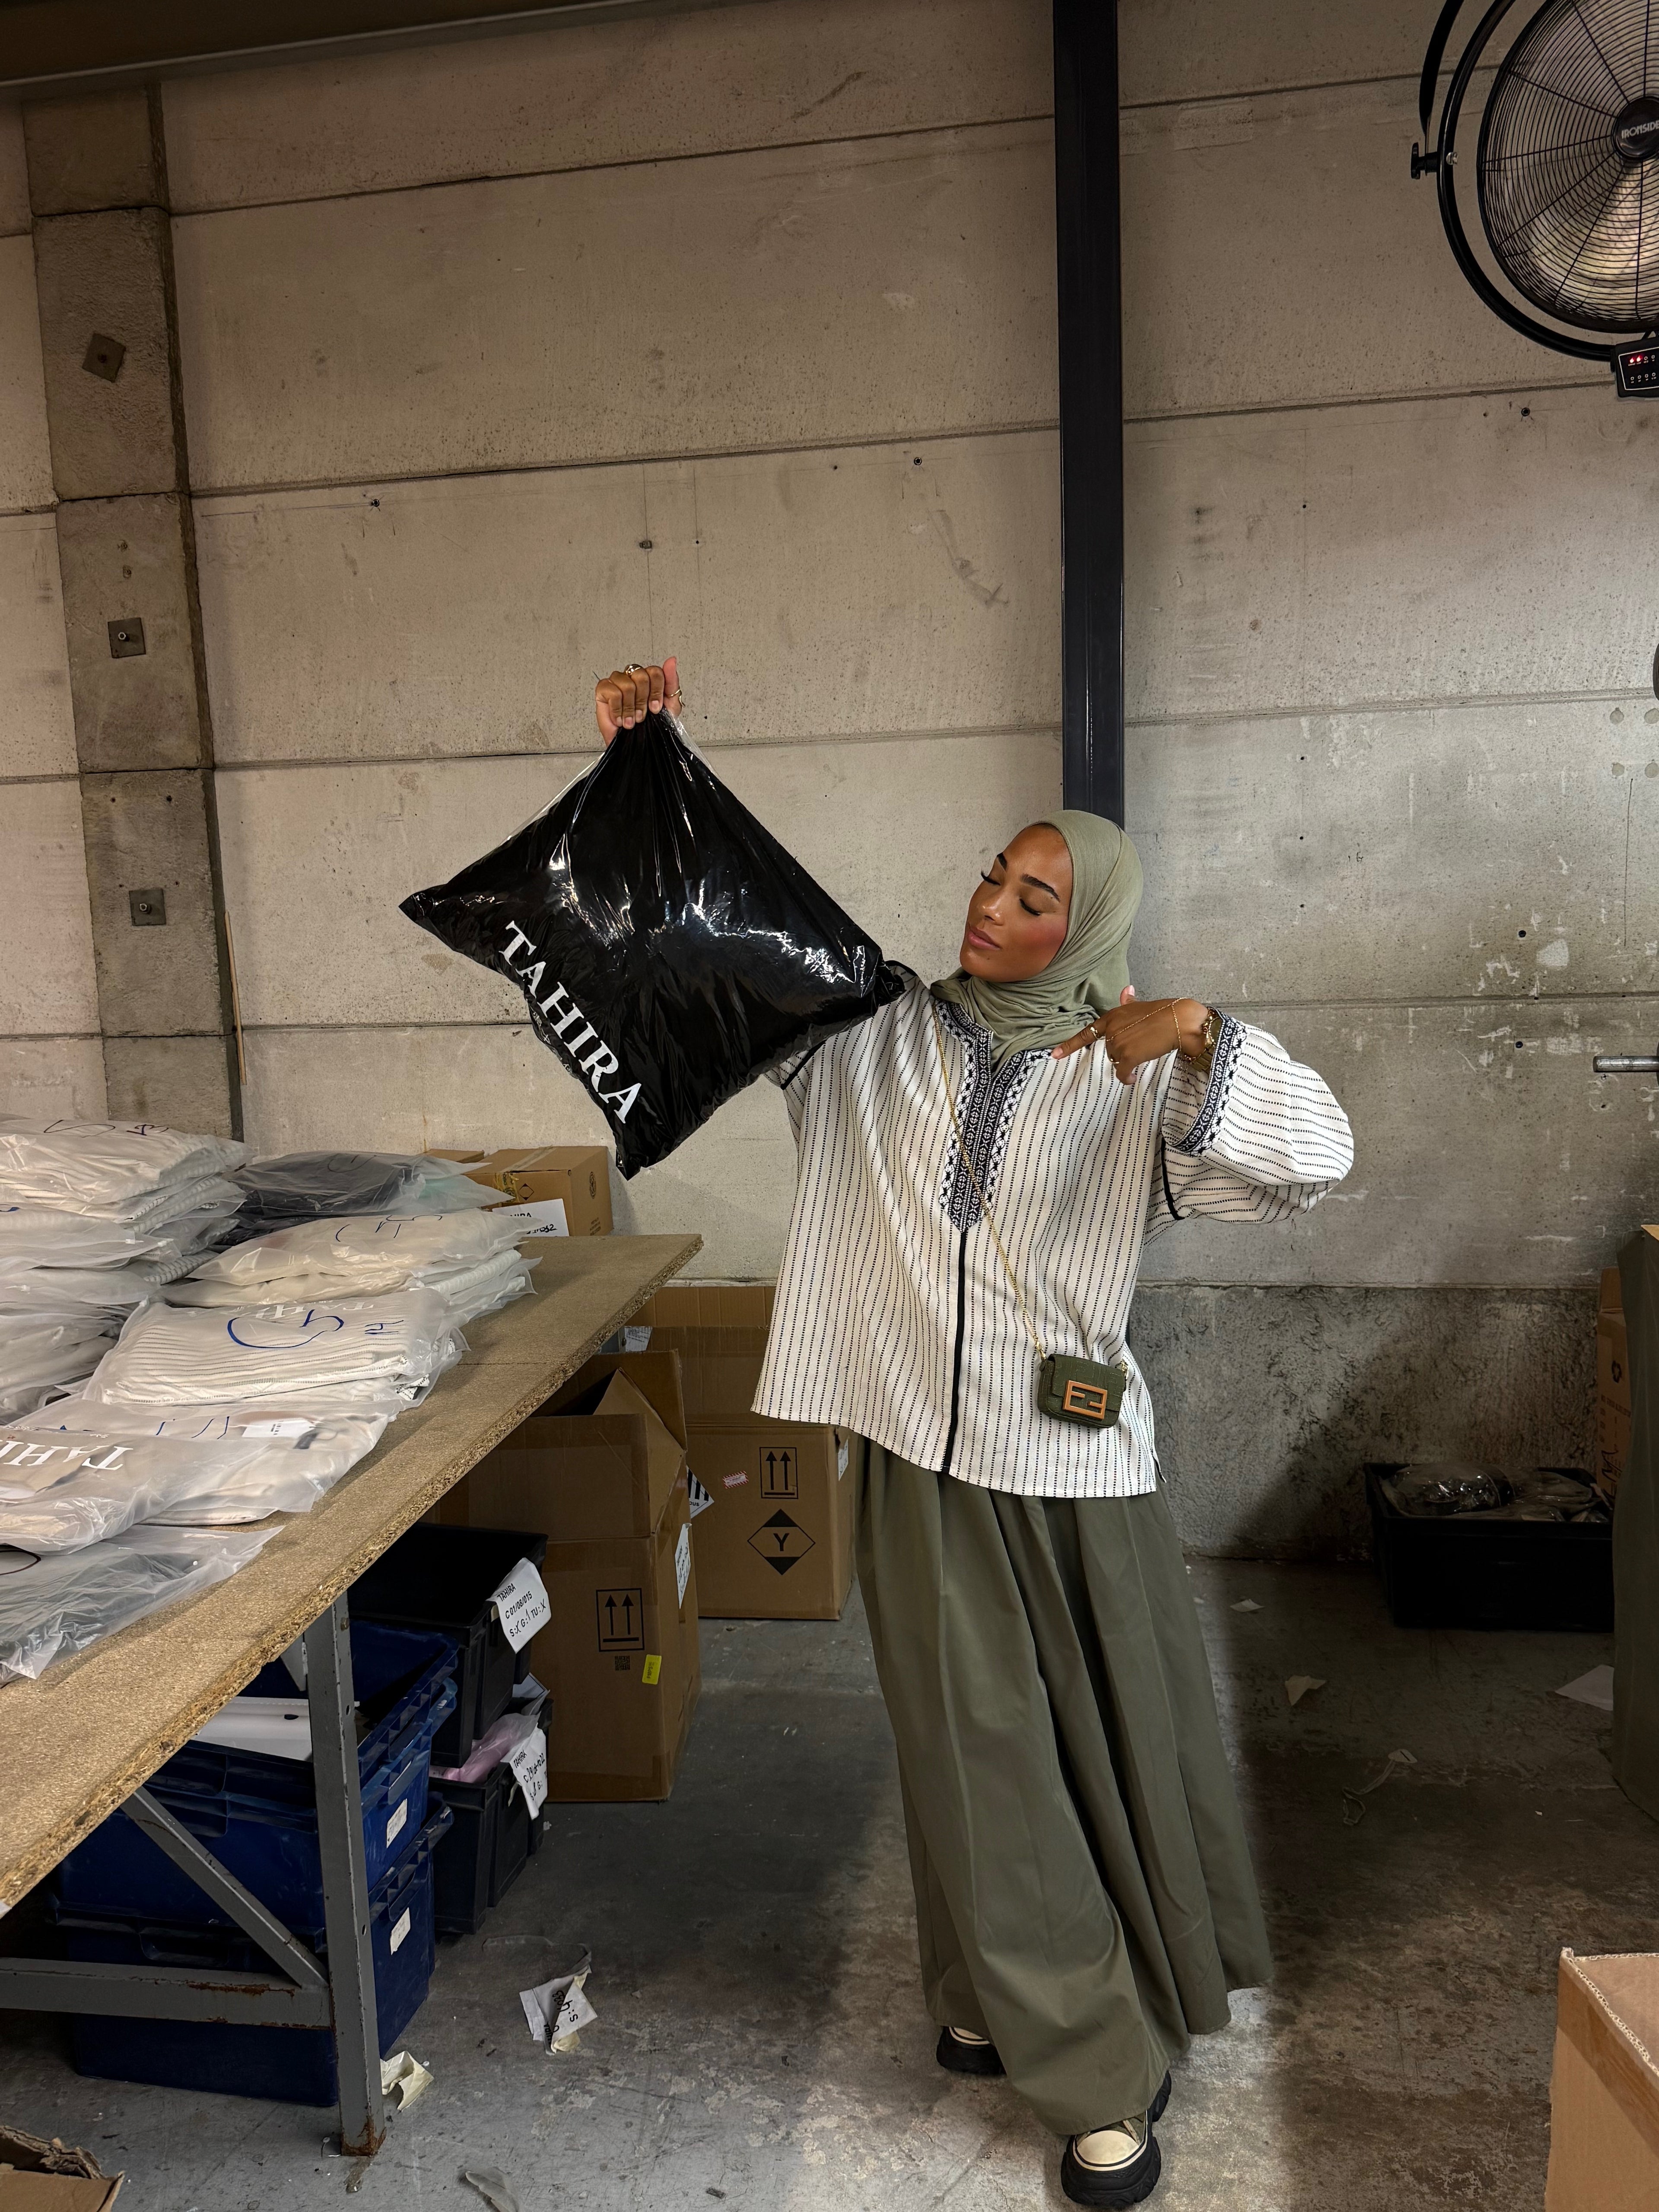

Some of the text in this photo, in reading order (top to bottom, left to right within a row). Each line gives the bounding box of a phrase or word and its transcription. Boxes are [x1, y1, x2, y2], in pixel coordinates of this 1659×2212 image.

[1621, 120, 1659, 139] IRONSIDE
[499, 920, 642, 1124] TAHIRA
[773, 1533, 790, 1551] Y
[497, 1583, 516, 1602] TAHIRA
